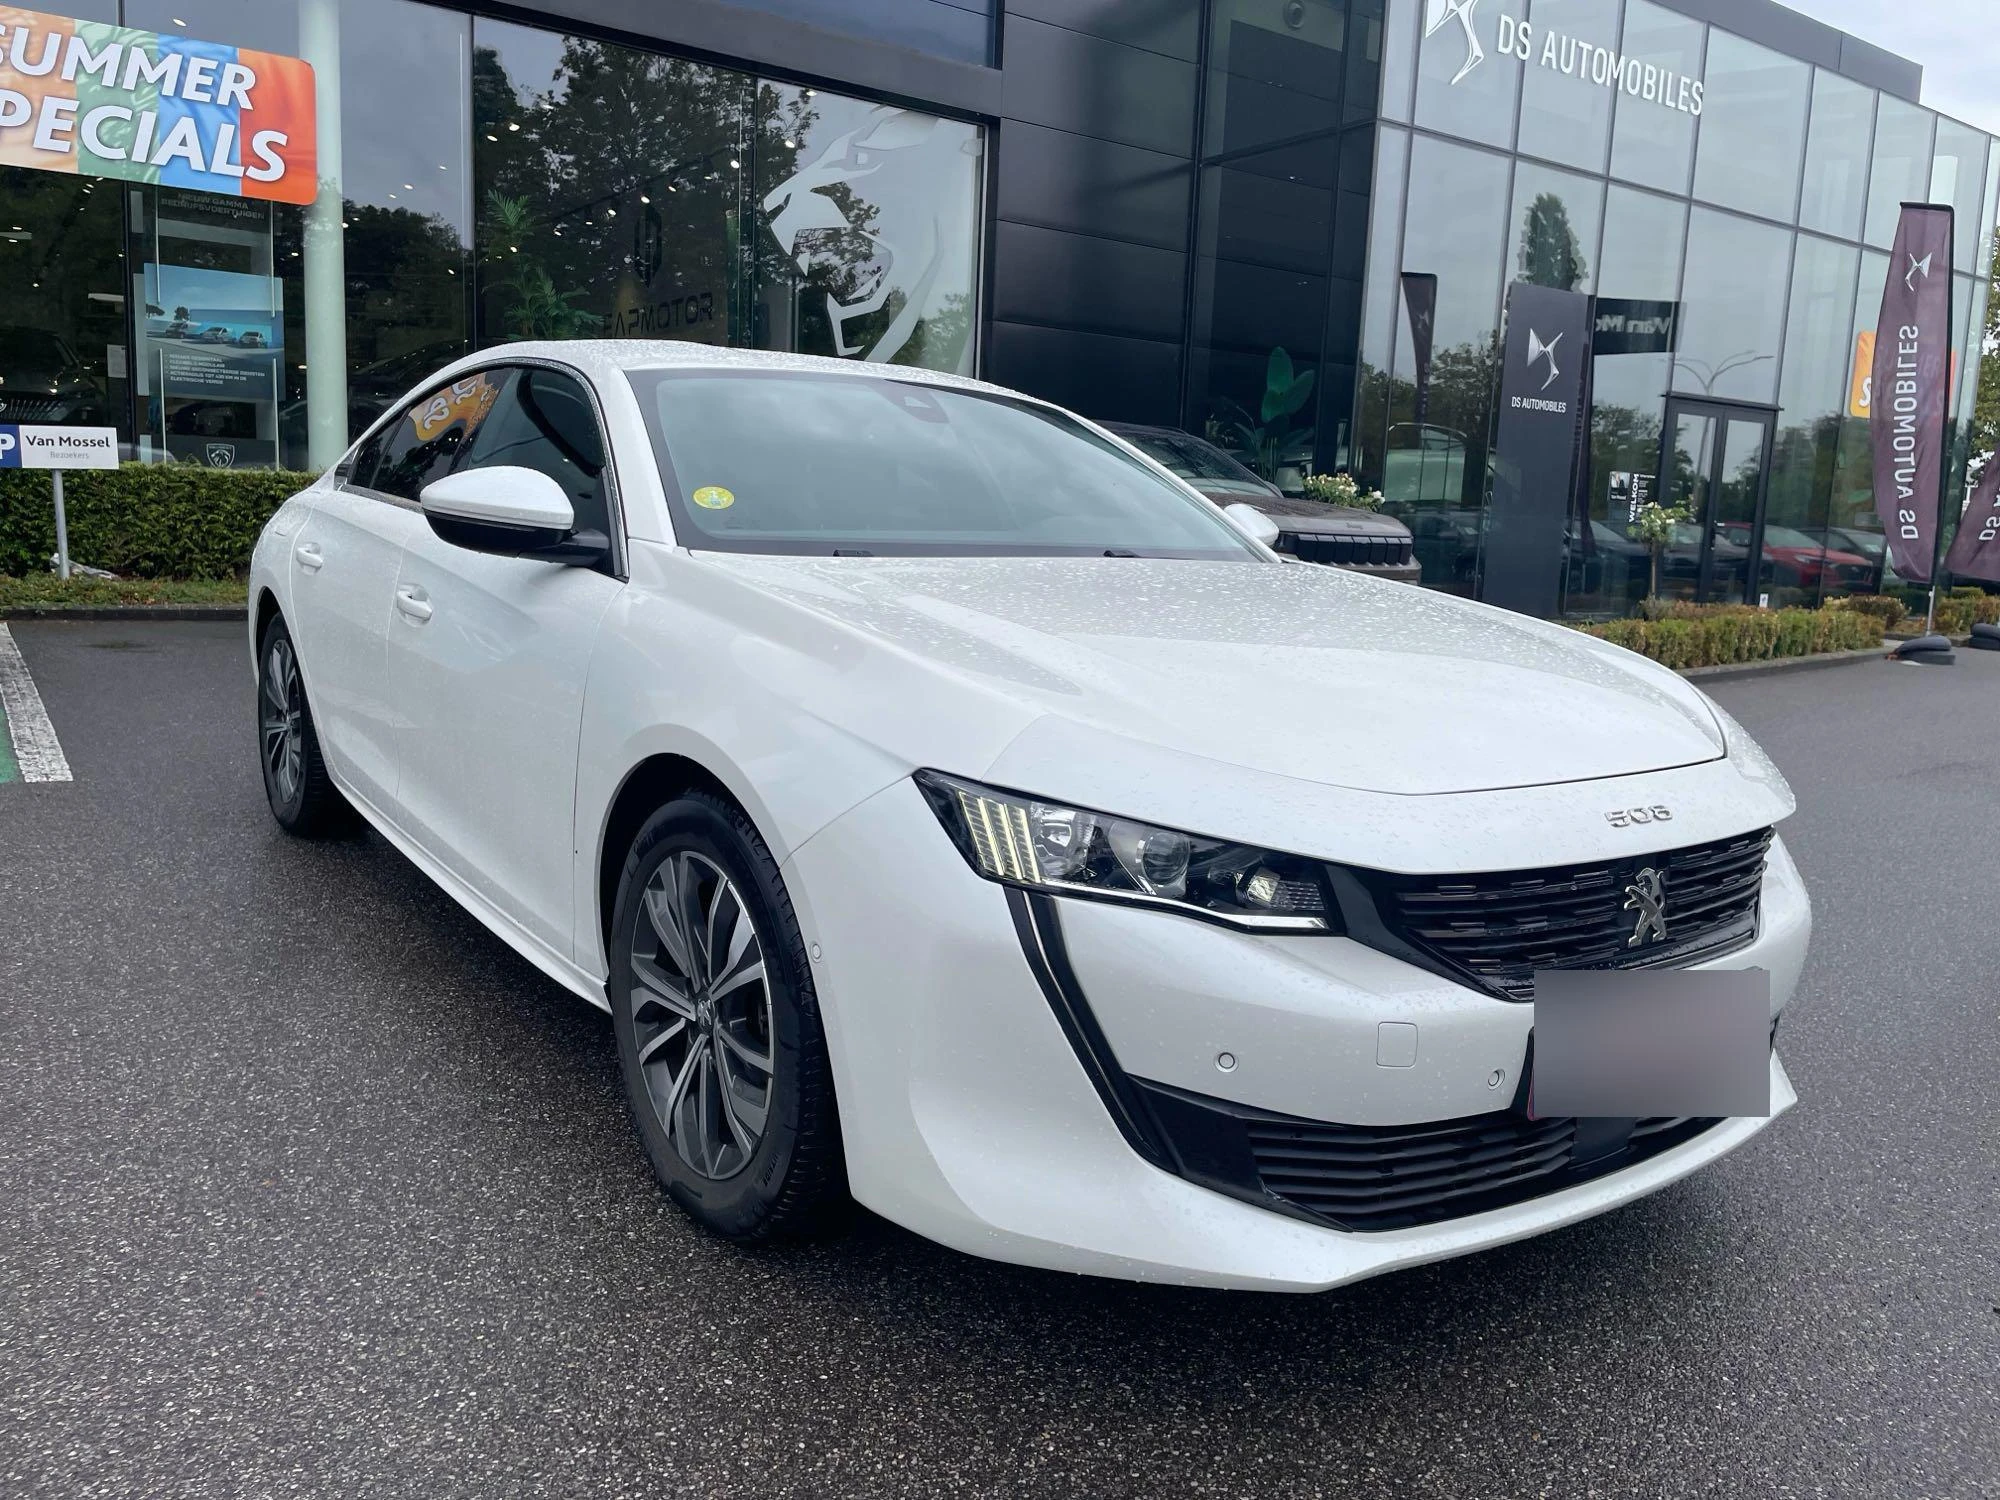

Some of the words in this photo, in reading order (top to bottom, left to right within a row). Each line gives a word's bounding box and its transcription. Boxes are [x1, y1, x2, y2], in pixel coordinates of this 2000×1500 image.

[0, 24, 254, 111] UMMER
[1498, 14, 1532, 60] DS
[1541, 30, 1704, 116] AUTOMOBILES
[1511, 396, 1521, 408] DS
[1522, 397, 1567, 413] AUTOMOBILES
[26, 435, 55, 447] Van
[59, 436, 110, 448] Mossel
[1629, 473, 1640, 523] WELKOM
